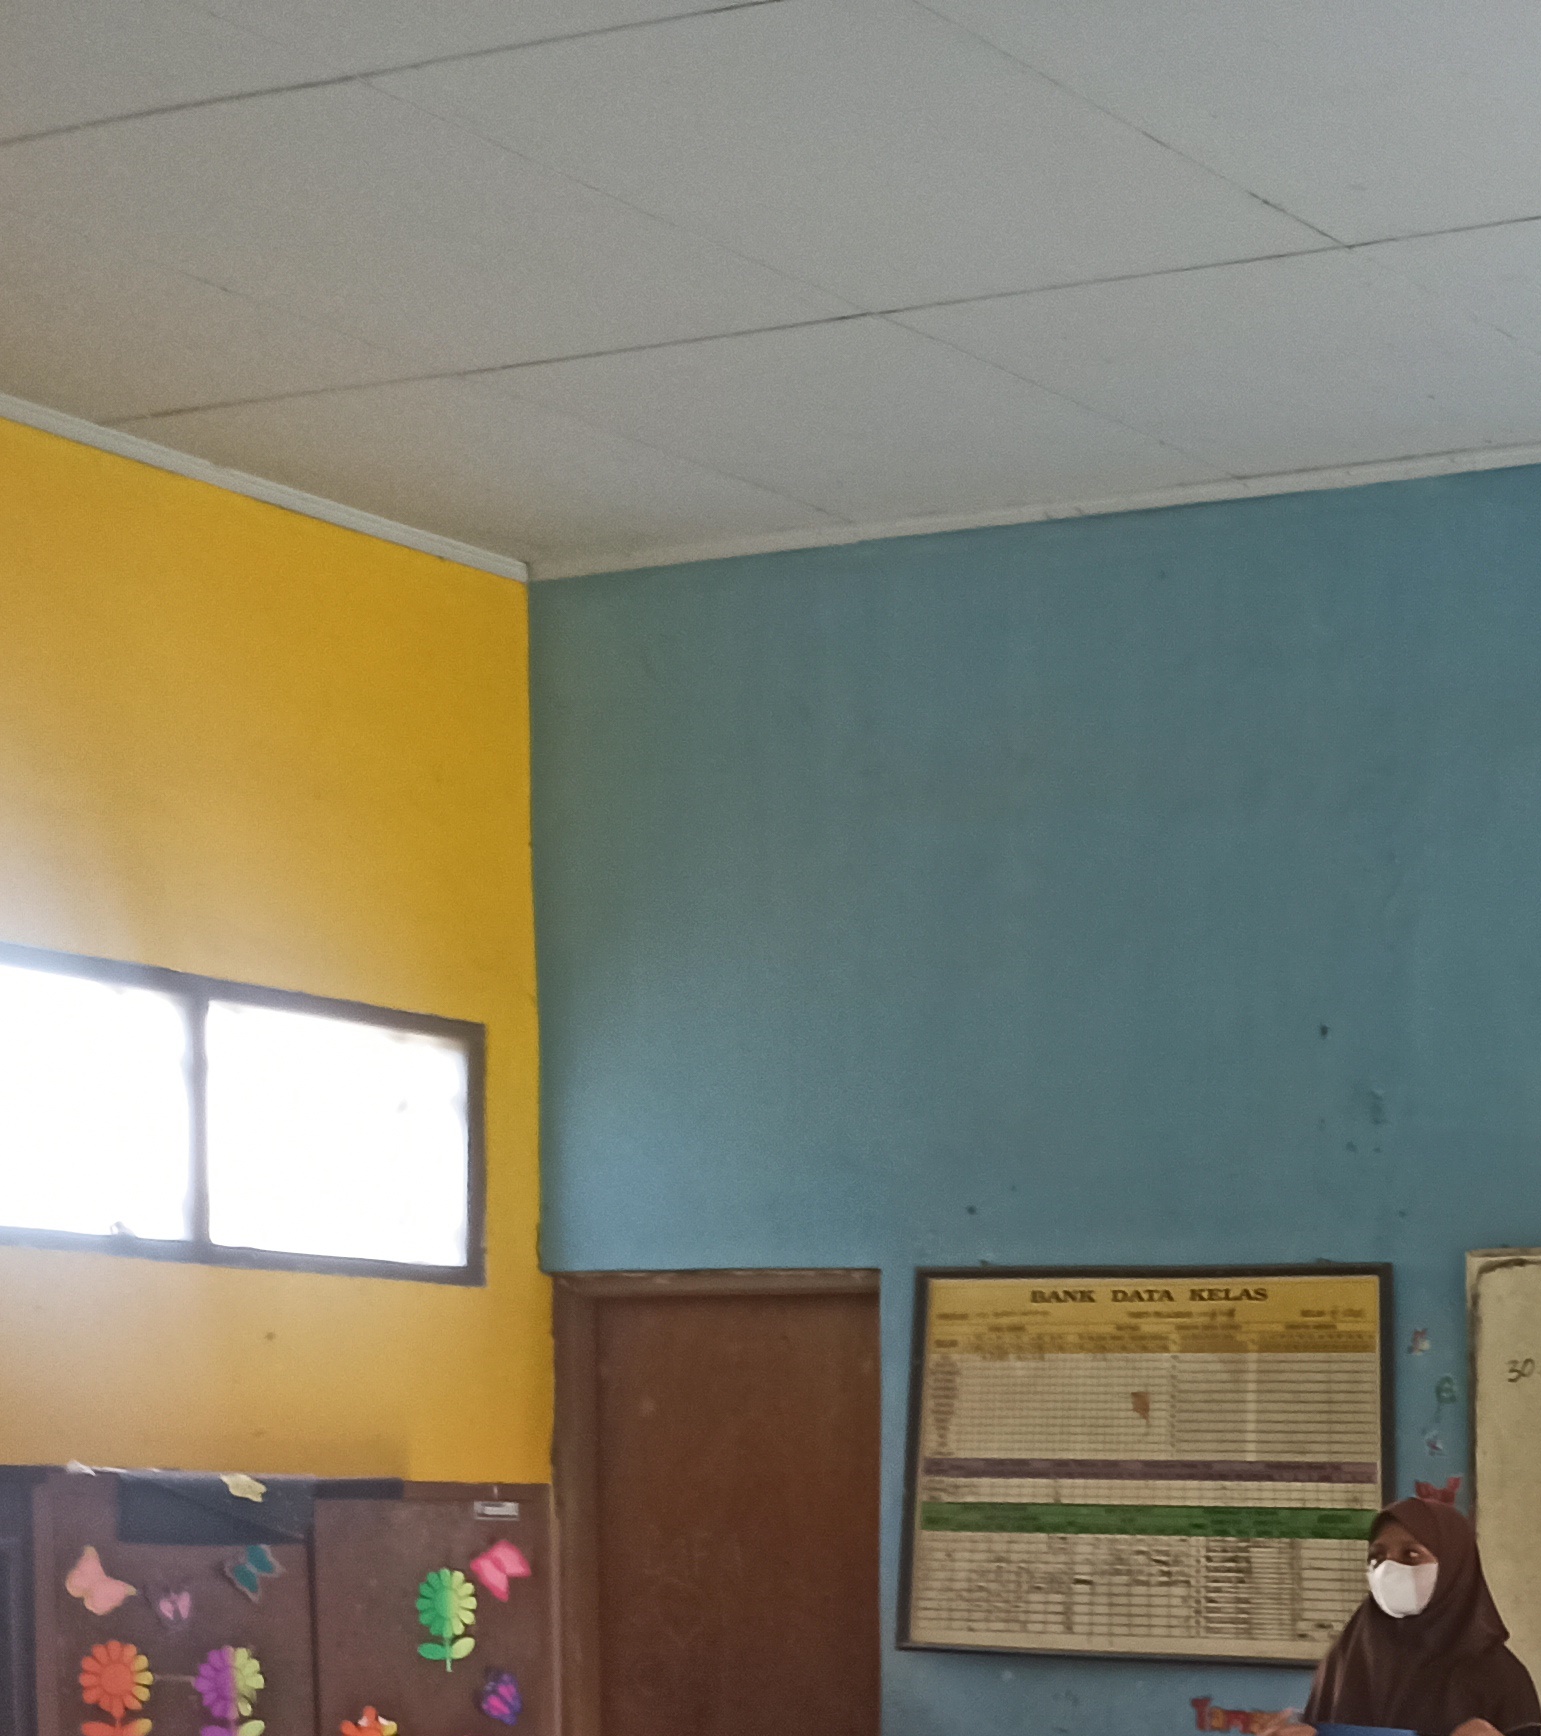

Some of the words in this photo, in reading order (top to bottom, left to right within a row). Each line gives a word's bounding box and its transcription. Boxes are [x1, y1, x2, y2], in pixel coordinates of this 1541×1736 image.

[1030, 1289, 1095, 1304] BANK
[1111, 1289, 1174, 1303] DATA
[1189, 1287, 1269, 1302] KELAS
